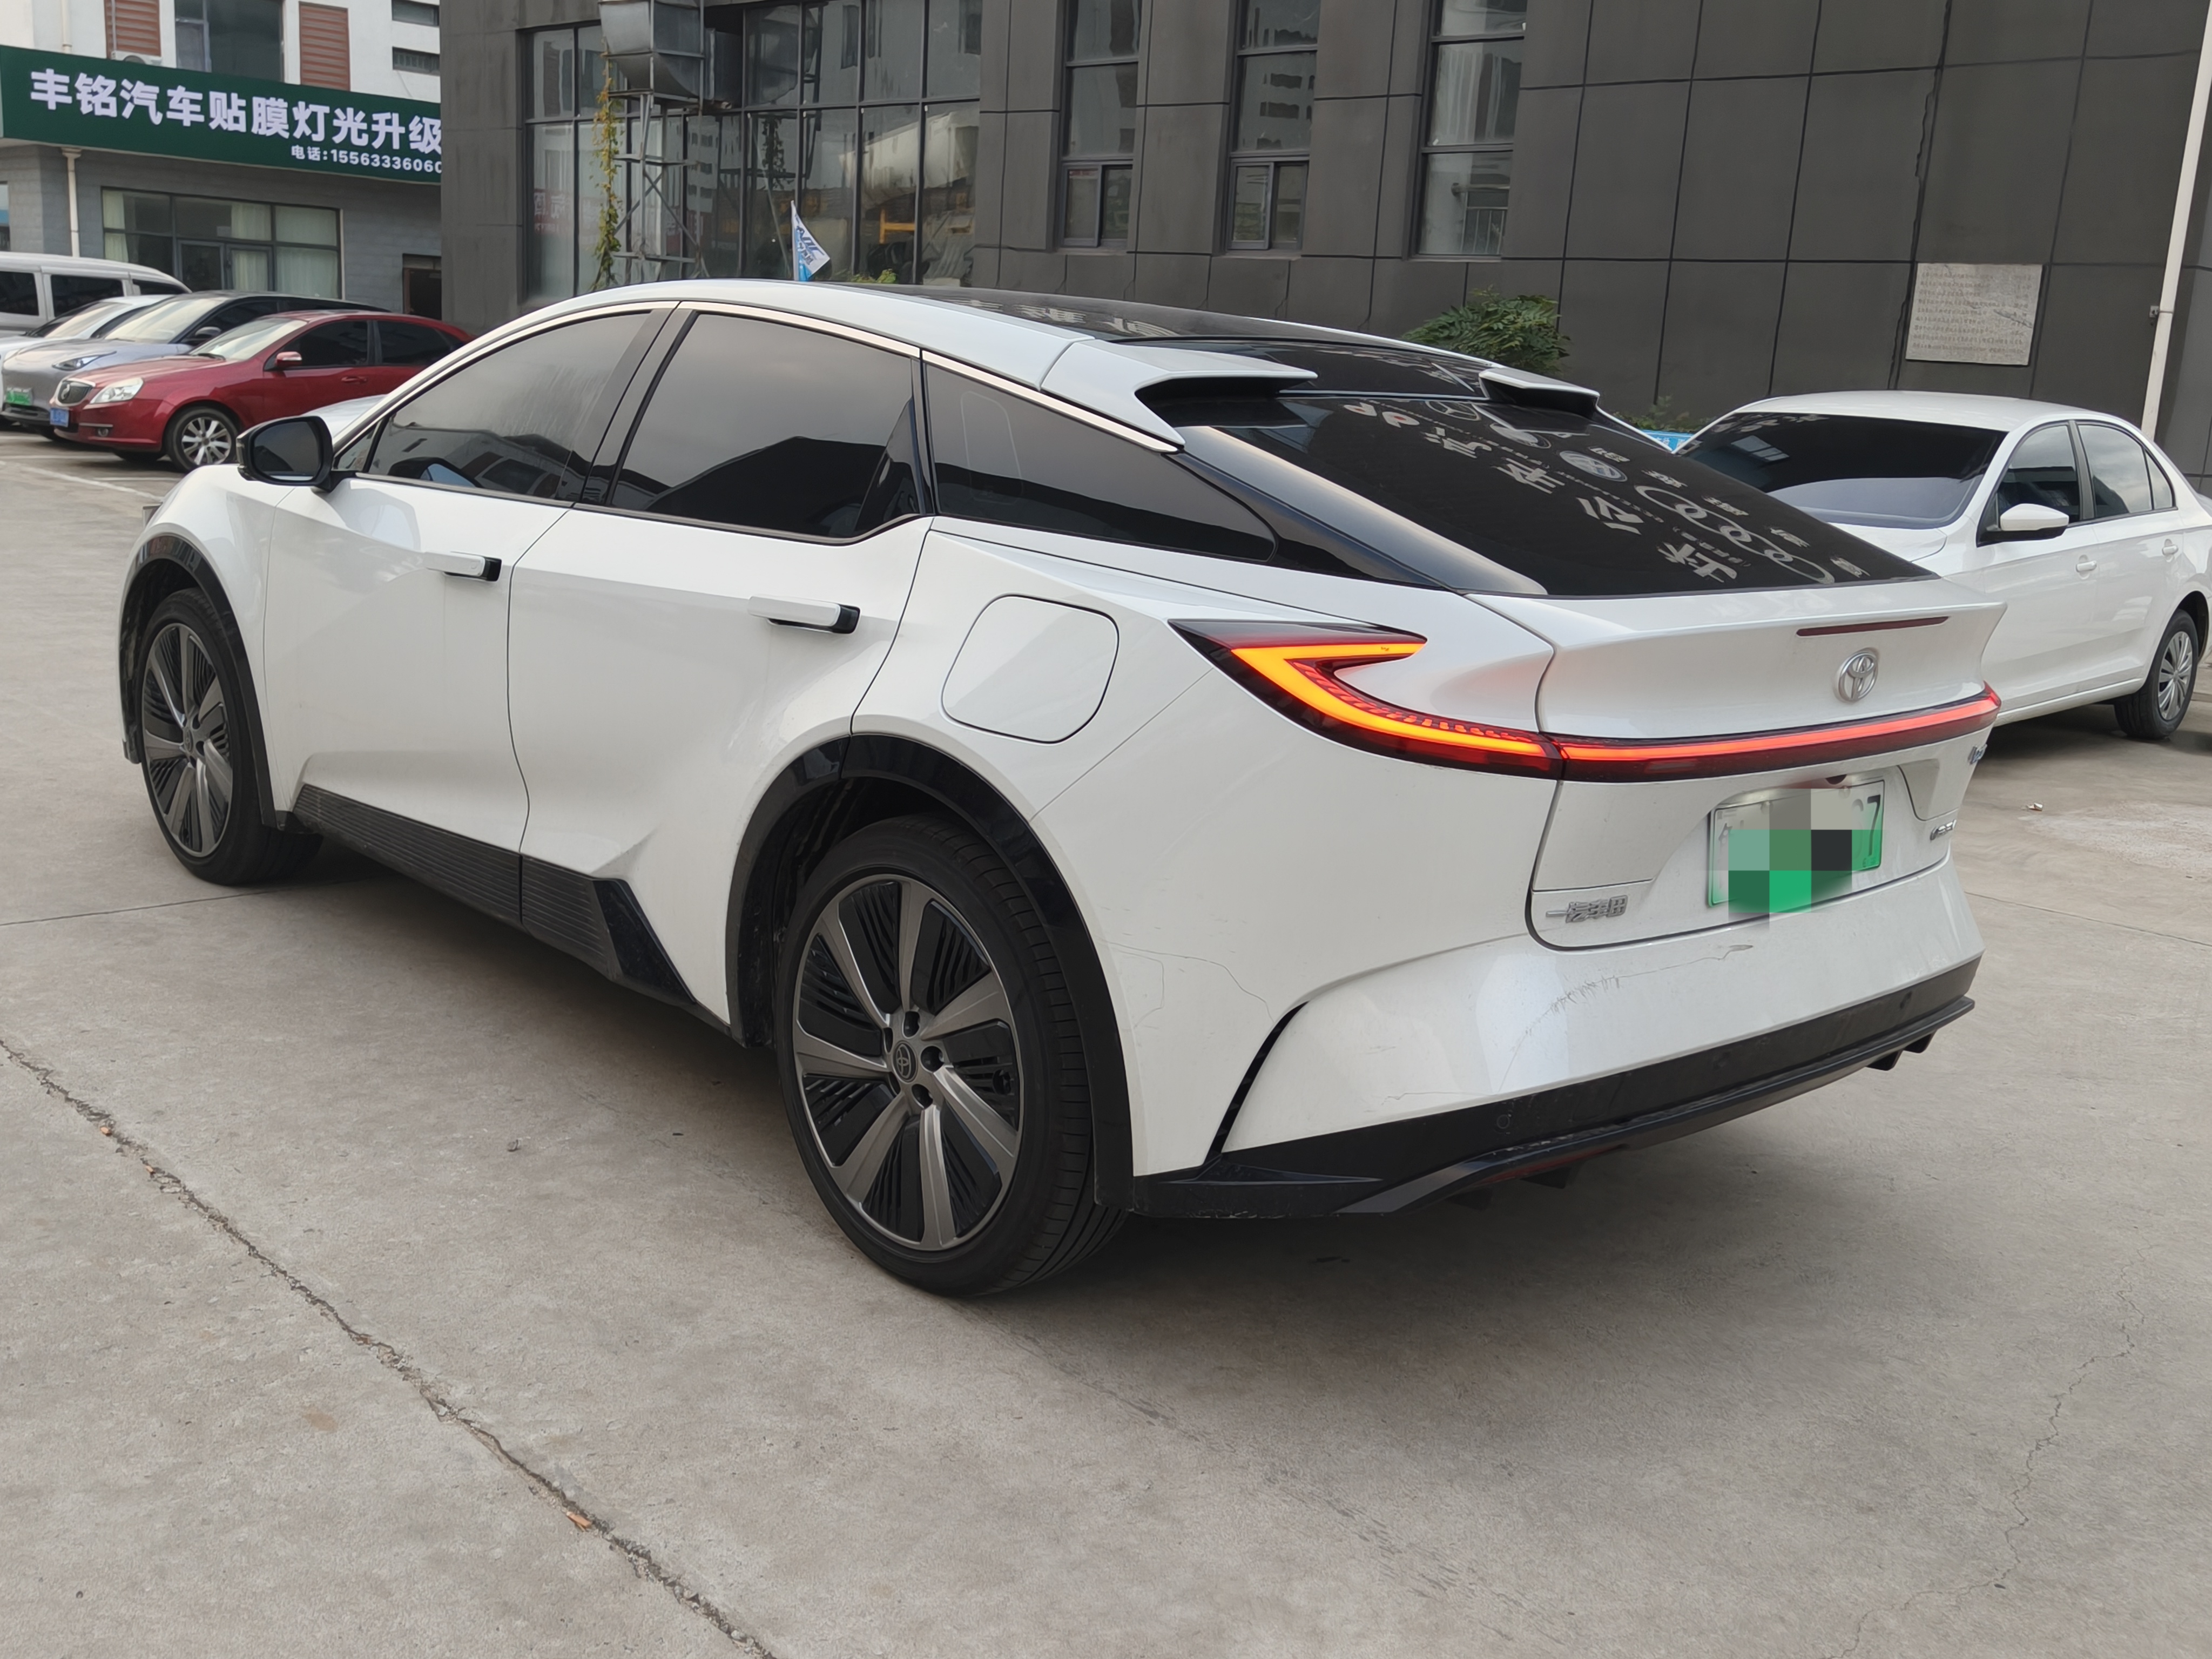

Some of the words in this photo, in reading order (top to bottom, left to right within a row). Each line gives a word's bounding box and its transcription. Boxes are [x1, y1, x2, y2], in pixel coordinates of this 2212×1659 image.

[30, 68, 441, 155] 丰铭汽车贴膜灯光升级
